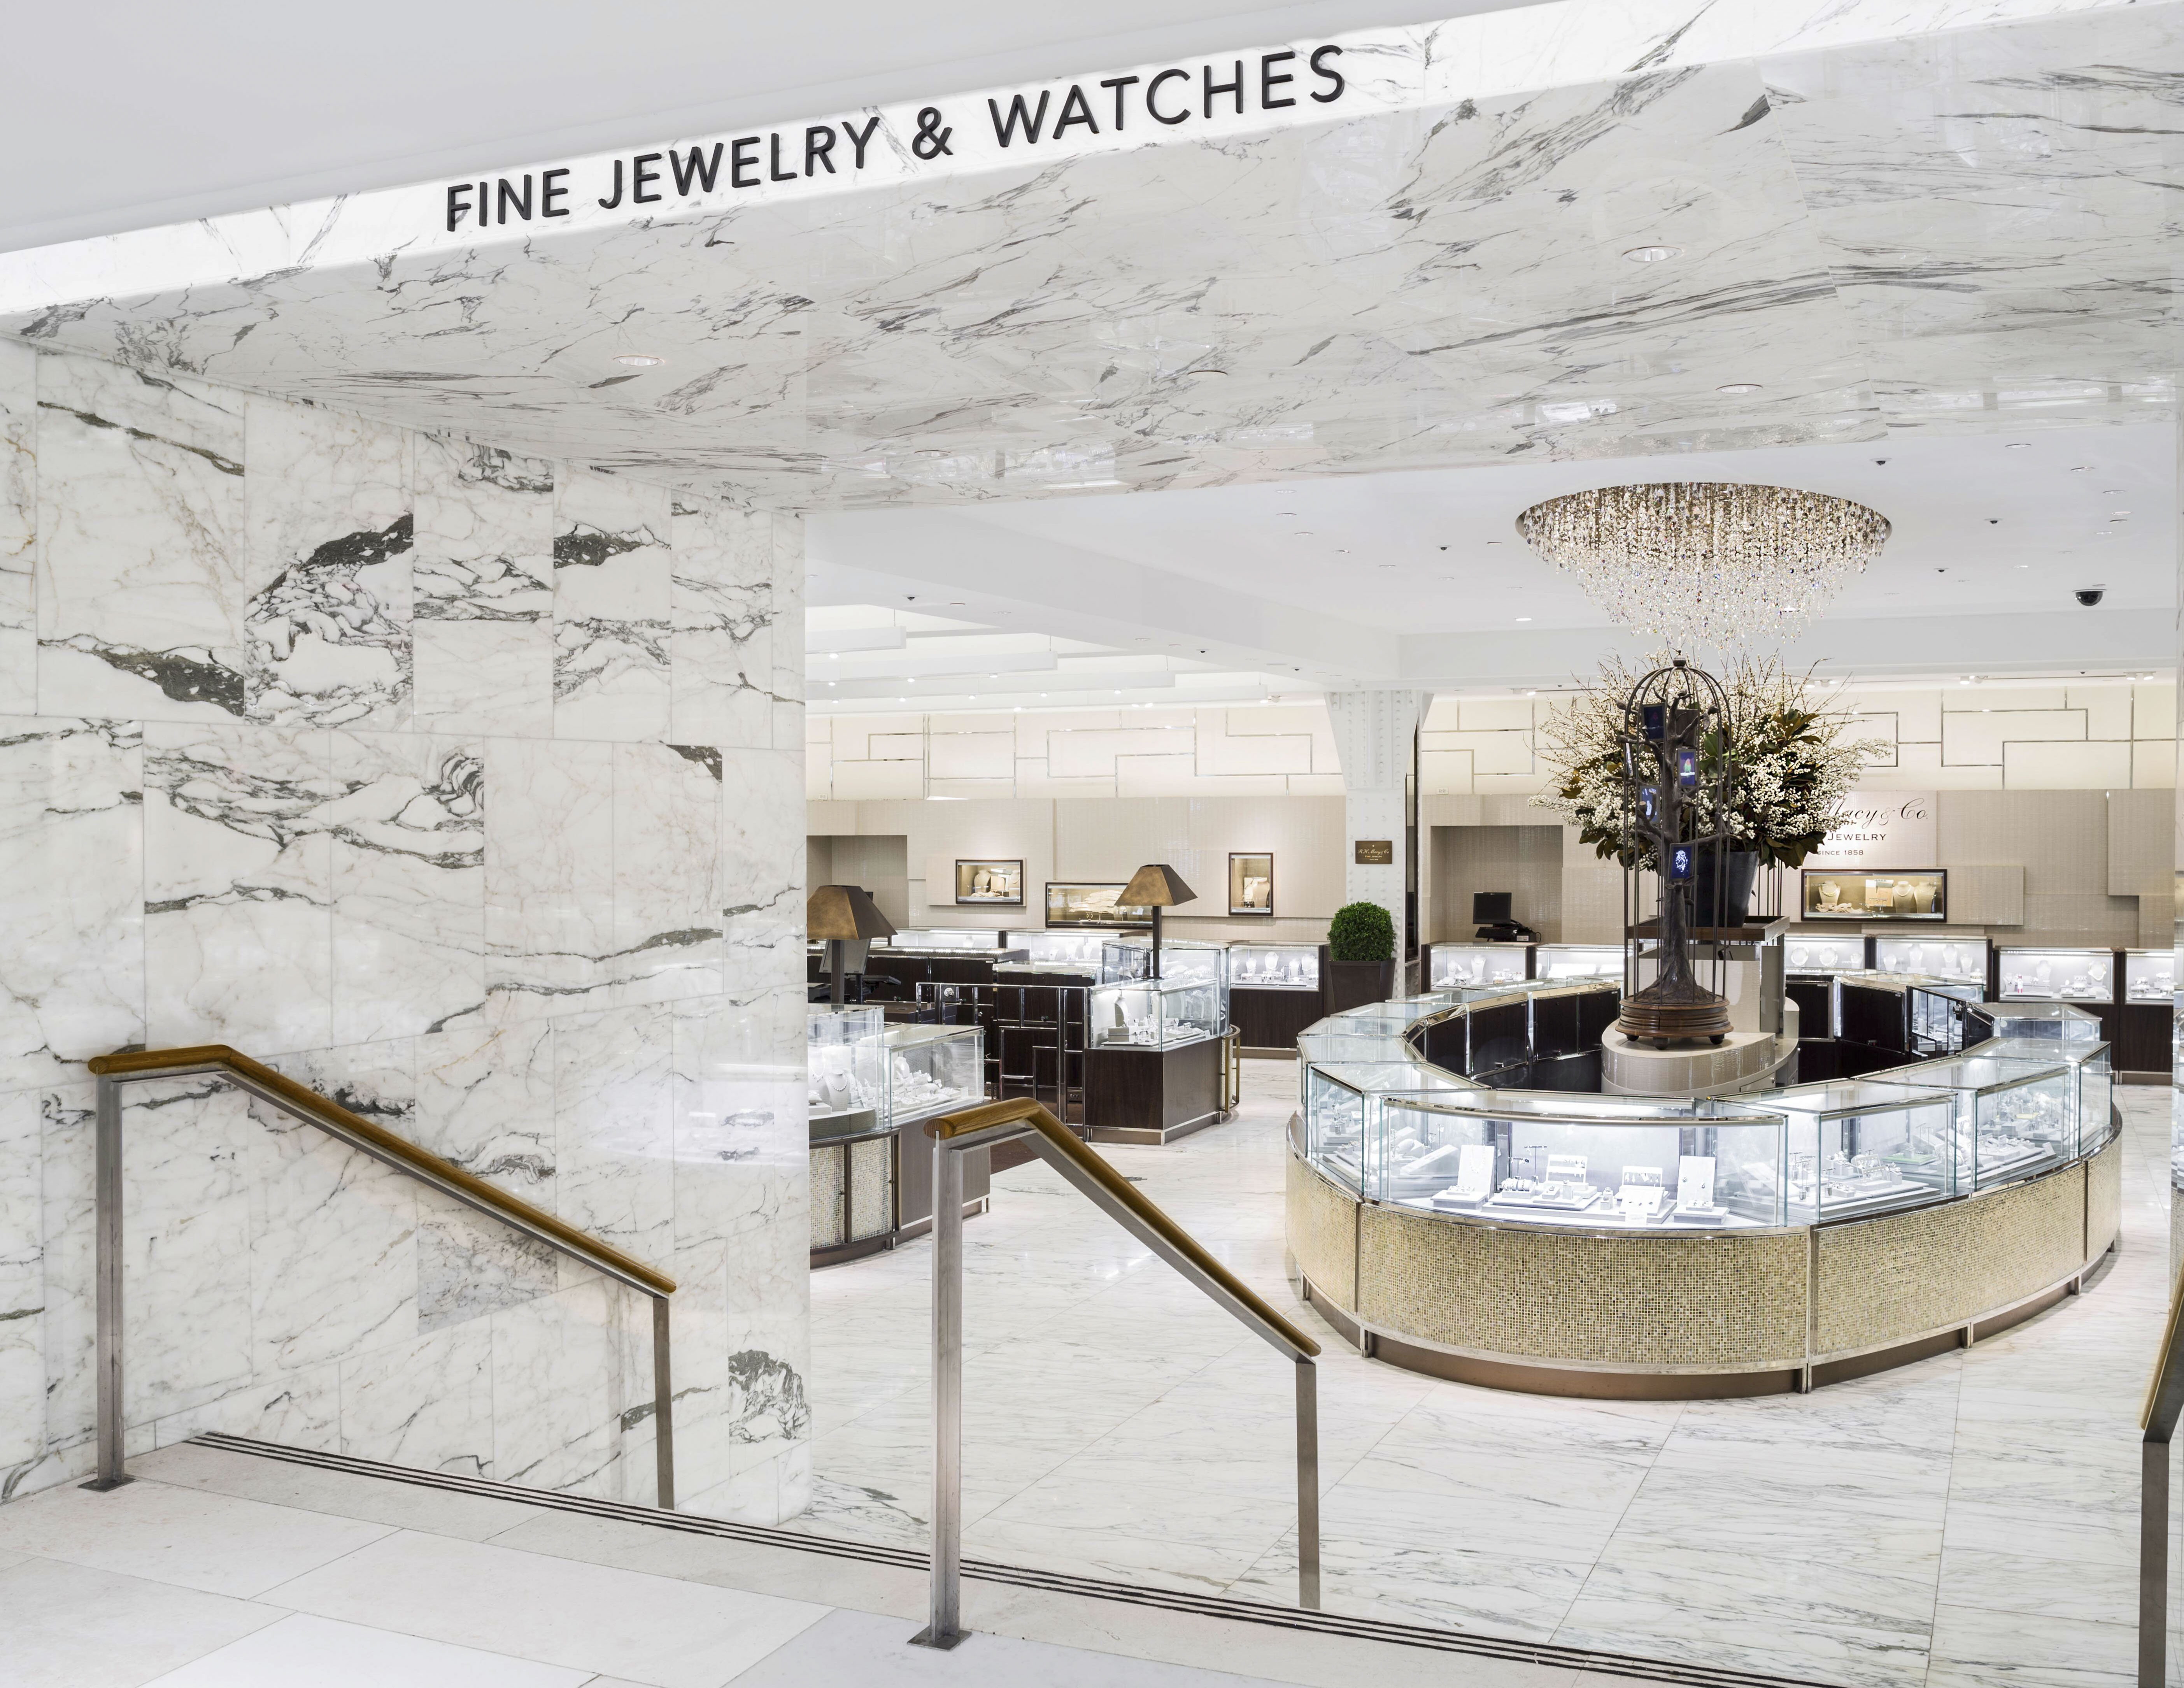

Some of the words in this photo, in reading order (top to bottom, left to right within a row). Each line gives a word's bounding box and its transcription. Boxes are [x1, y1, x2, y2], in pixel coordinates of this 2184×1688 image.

[447, 168, 570, 232] FINE
[598, 116, 880, 209] JEWELRY
[911, 107, 954, 160] &
[987, 45, 1344, 148] WATCHES
[1879, 807, 1895, 826] &
[1827, 833, 1886, 841] JEWELRY
